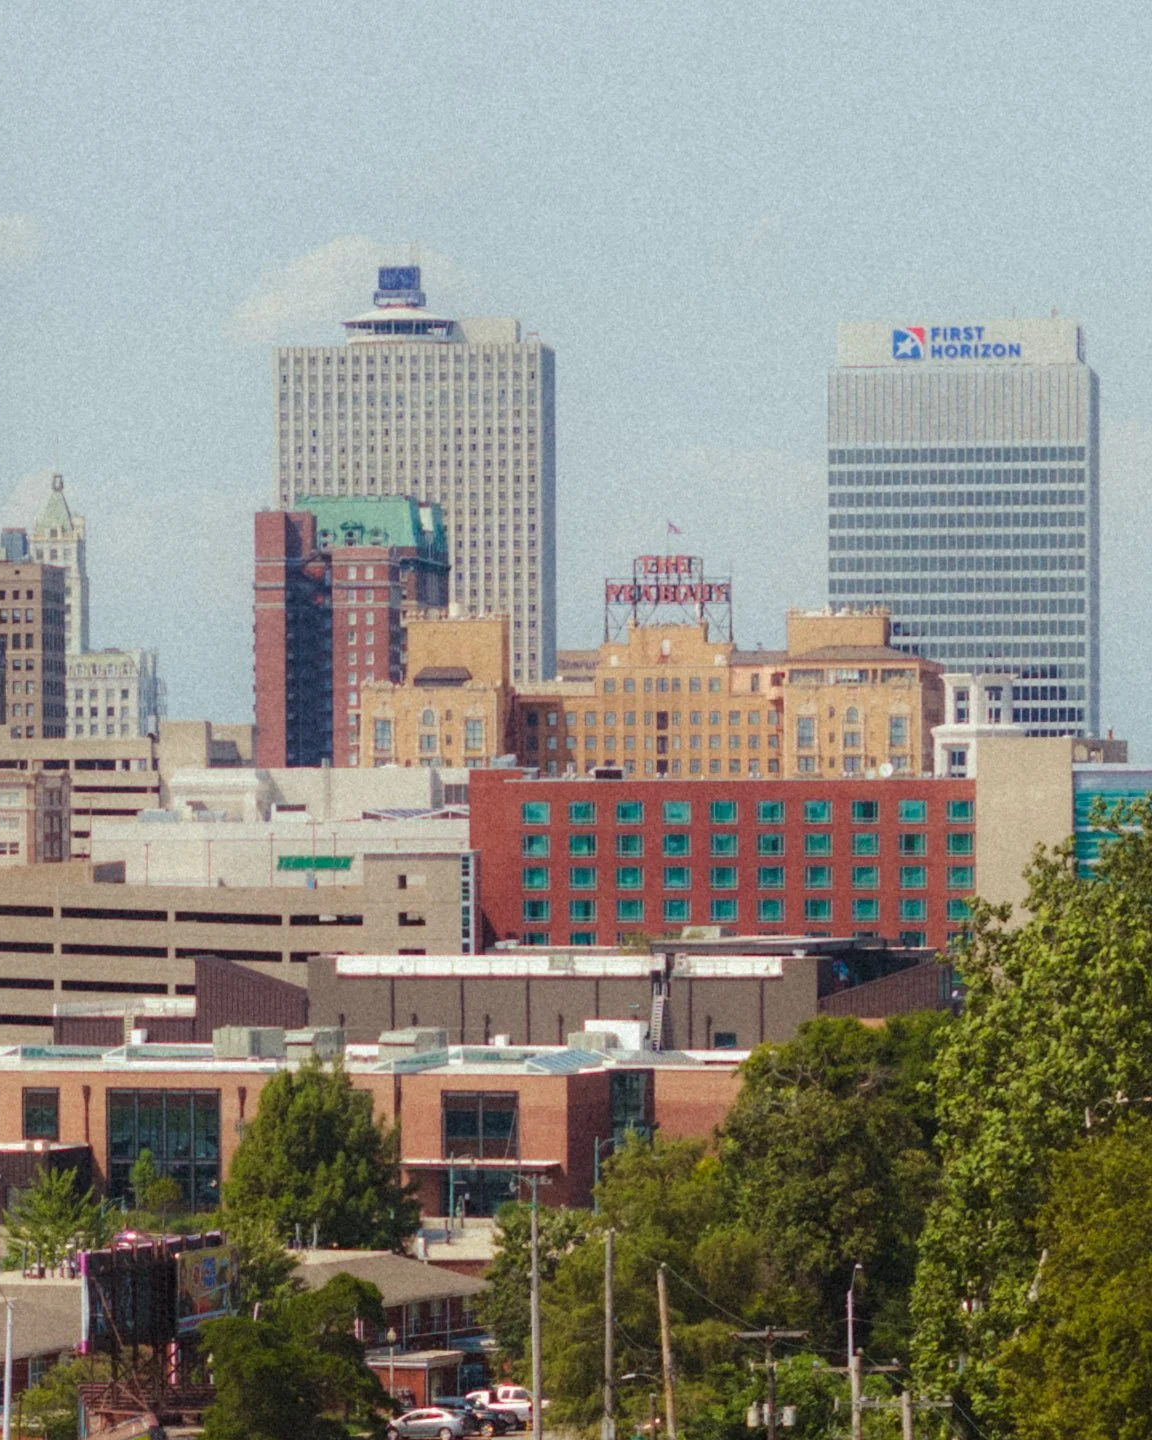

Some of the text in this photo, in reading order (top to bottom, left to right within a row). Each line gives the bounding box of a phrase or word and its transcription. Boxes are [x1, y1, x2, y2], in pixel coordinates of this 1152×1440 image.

[931, 326, 985, 341] FIRST
[931, 343, 1021, 358] HORIZON
[639, 555, 692, 574] THE
